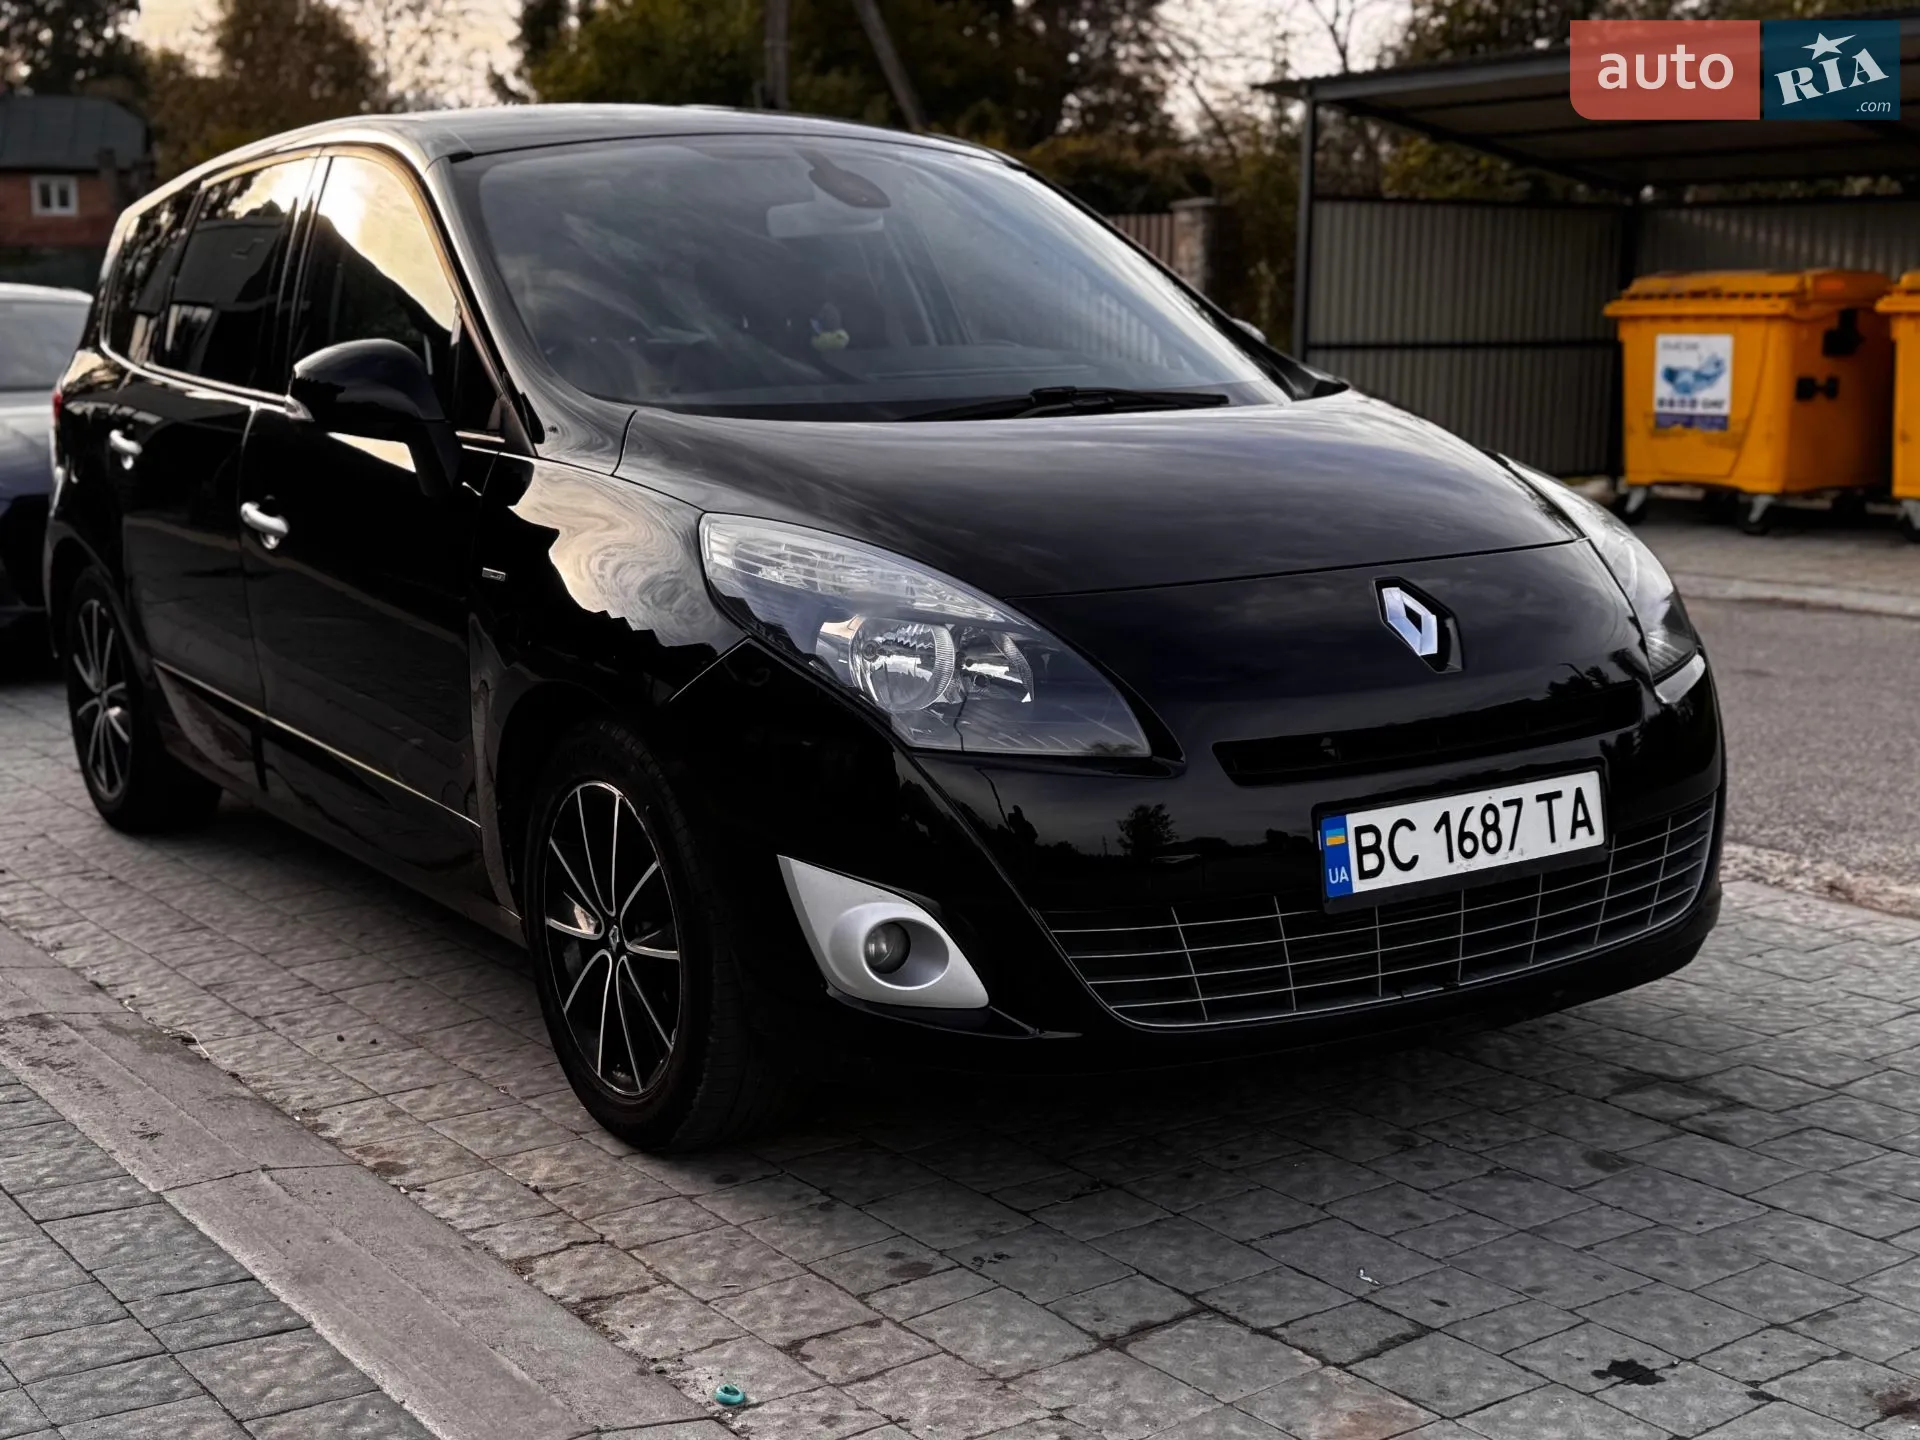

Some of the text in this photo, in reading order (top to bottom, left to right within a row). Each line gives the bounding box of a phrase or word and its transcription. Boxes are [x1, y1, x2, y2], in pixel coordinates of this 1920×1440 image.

[1354, 786, 1595, 880] BC 1687 TA
[1328, 867, 1350, 884] UA
